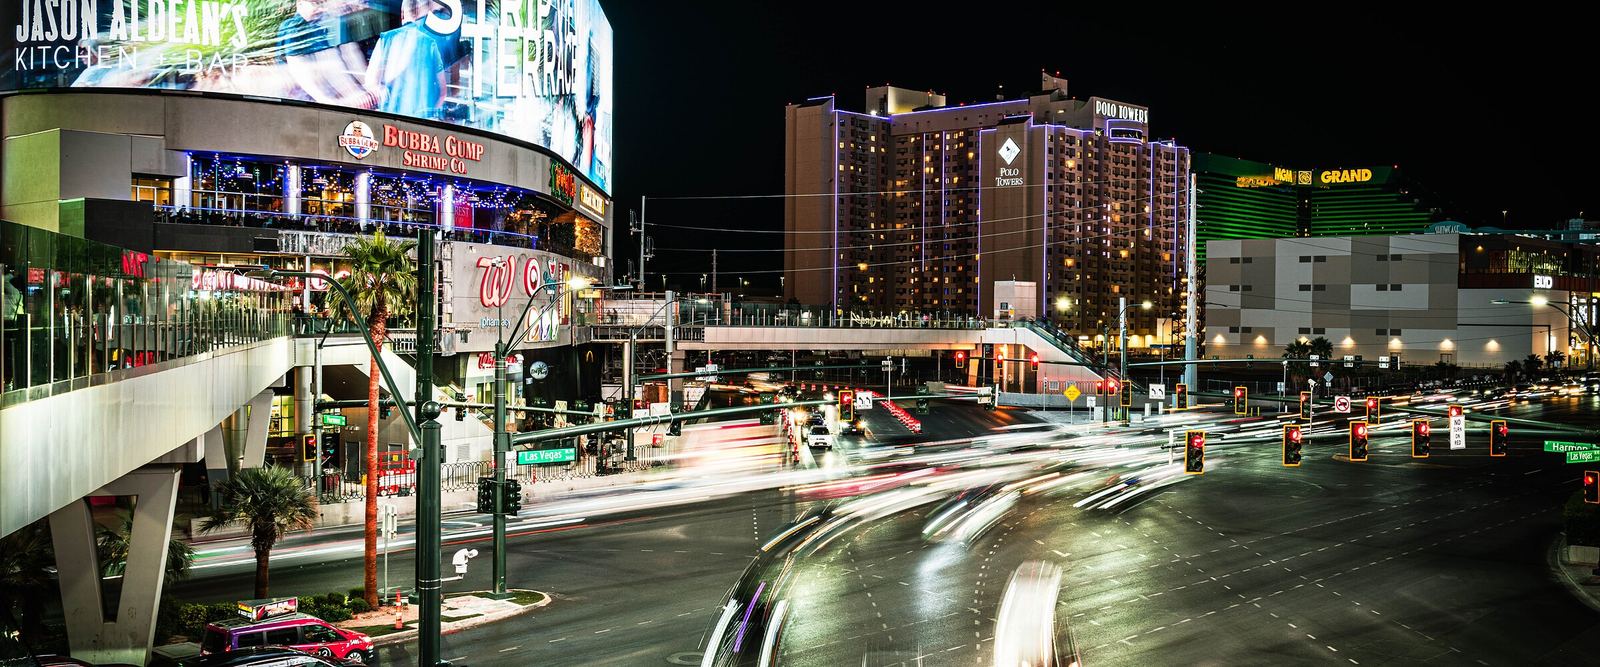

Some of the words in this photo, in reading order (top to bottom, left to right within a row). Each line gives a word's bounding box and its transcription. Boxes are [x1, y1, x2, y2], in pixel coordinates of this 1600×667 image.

[16, 0, 98, 42] JASON
[110, 0, 248, 49] ALDEAN'S
[15, 45, 137, 71] KITCHEN
[461, 25, 578, 98] TERRACE
[1096, 100, 1116, 118] POLO
[1119, 105, 1148, 124] TOWERS
[383, 124, 441, 154] BUBBA
[445, 135, 484, 161] GUMP
[403, 150, 447, 170] SHRIMP
[1000, 167, 1019, 176] POLO
[1275, 167, 1293, 183] MGM
[1321, 168, 1372, 184] GRAND
[996, 177, 1023, 187] TOWERS
[525, 452, 538, 462] Las
[540, 449, 562, 463] Vegas
[1570, 451, 1579, 461] Las
[1579, 451, 1593, 463] Vegas
